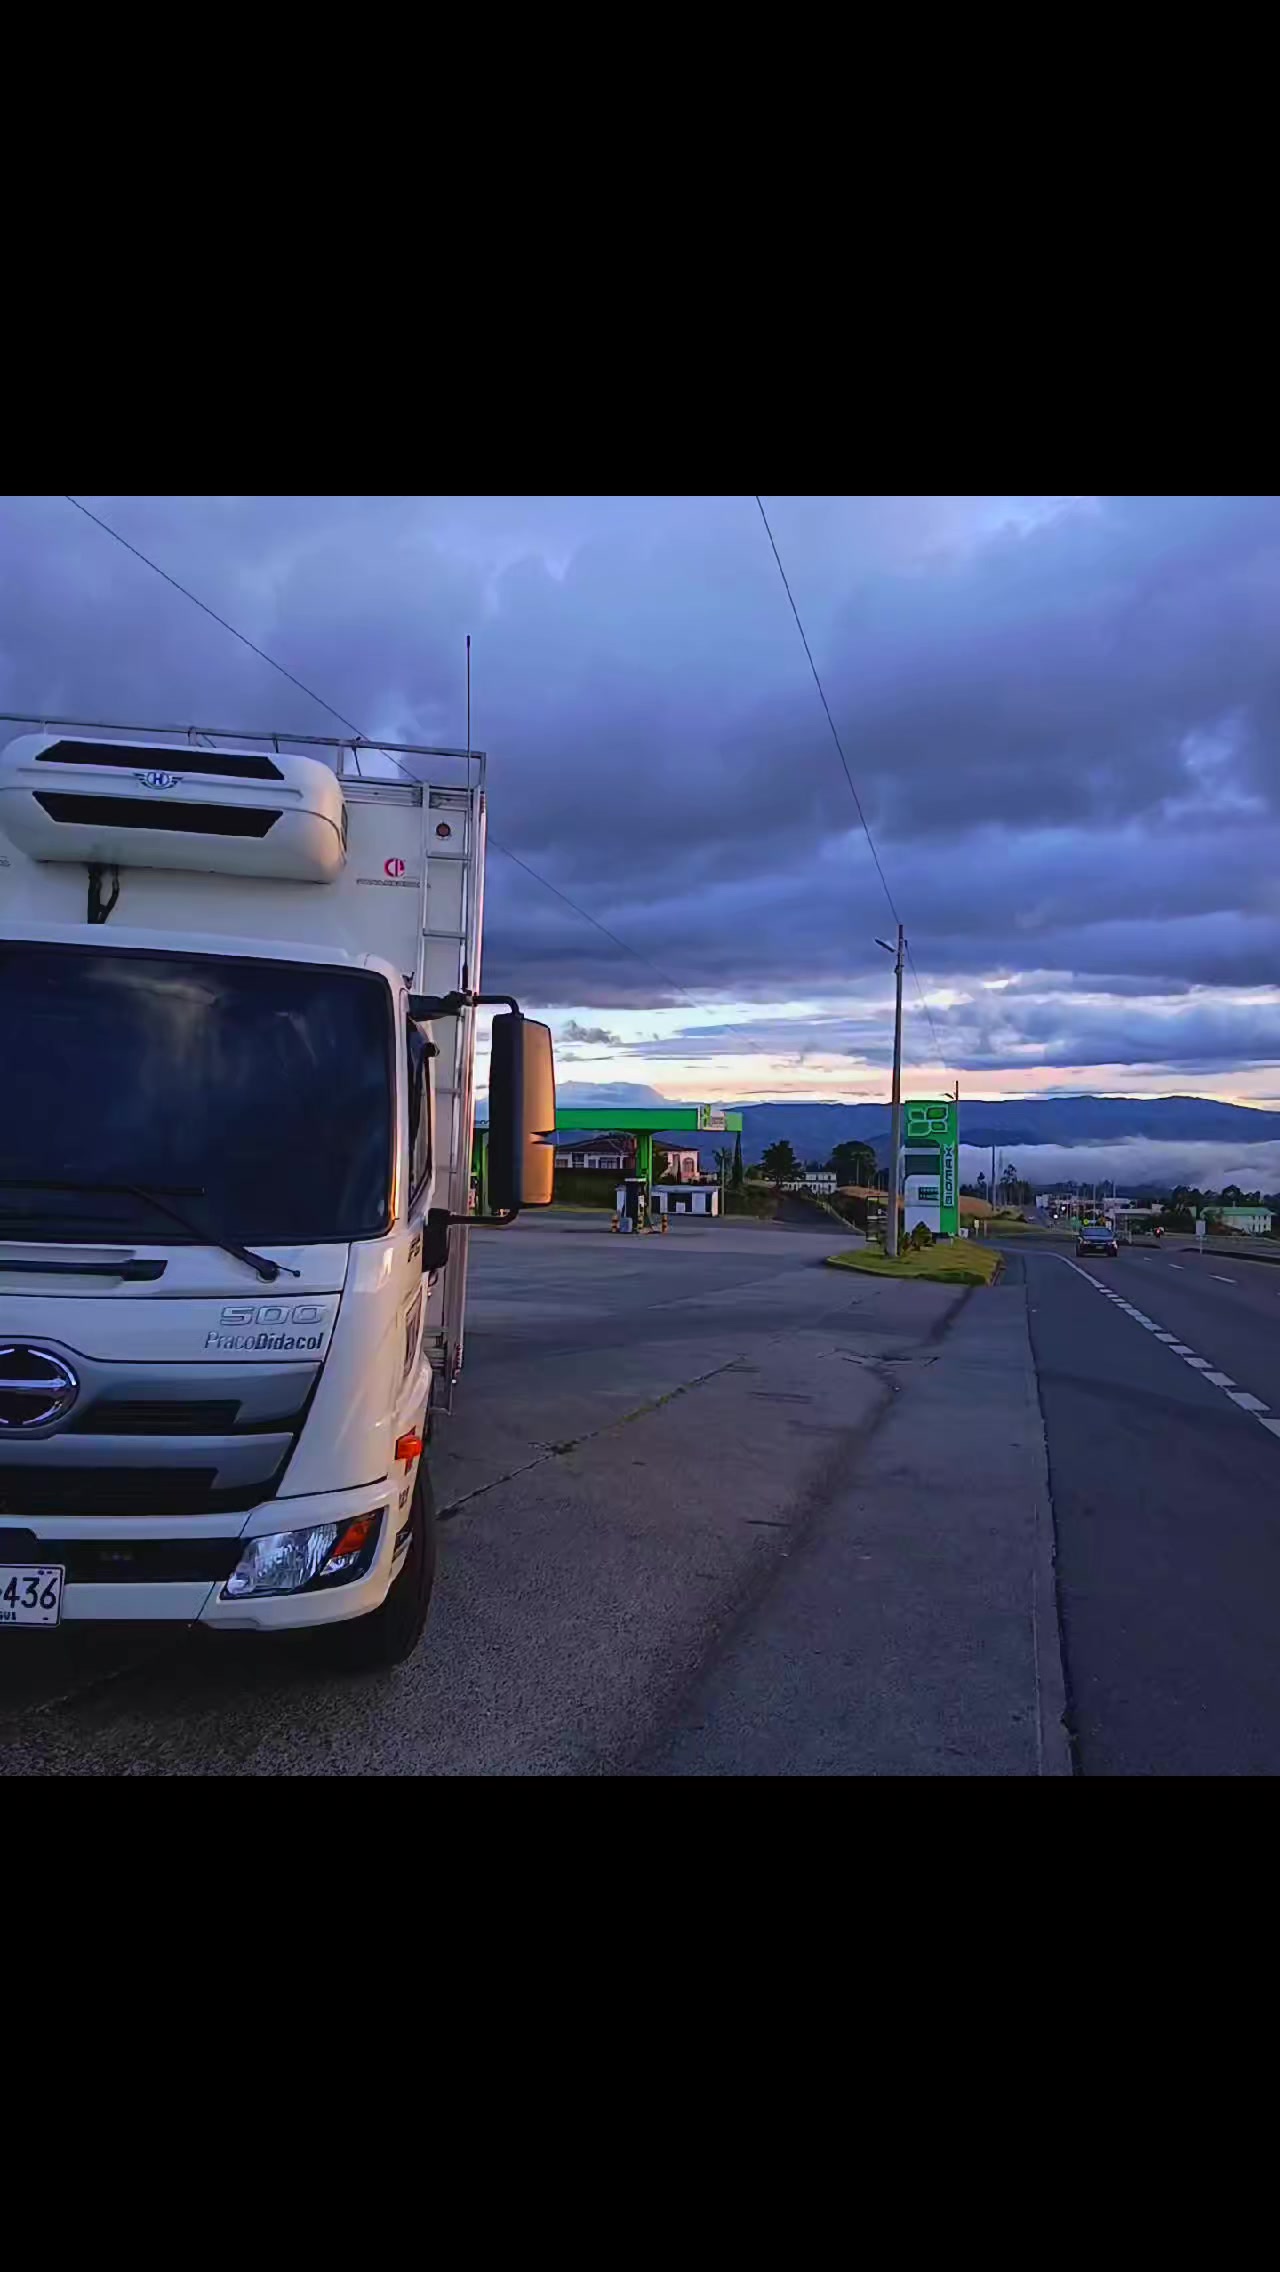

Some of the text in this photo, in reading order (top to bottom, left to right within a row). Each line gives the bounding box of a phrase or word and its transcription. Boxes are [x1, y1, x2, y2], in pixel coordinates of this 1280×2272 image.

[945, 1146, 953, 1205] BIOMAX
[220, 1304, 326, 1326] 500
[204, 1331, 324, 1350] PracoDidacol
[3, 1576, 58, 1610] 436
